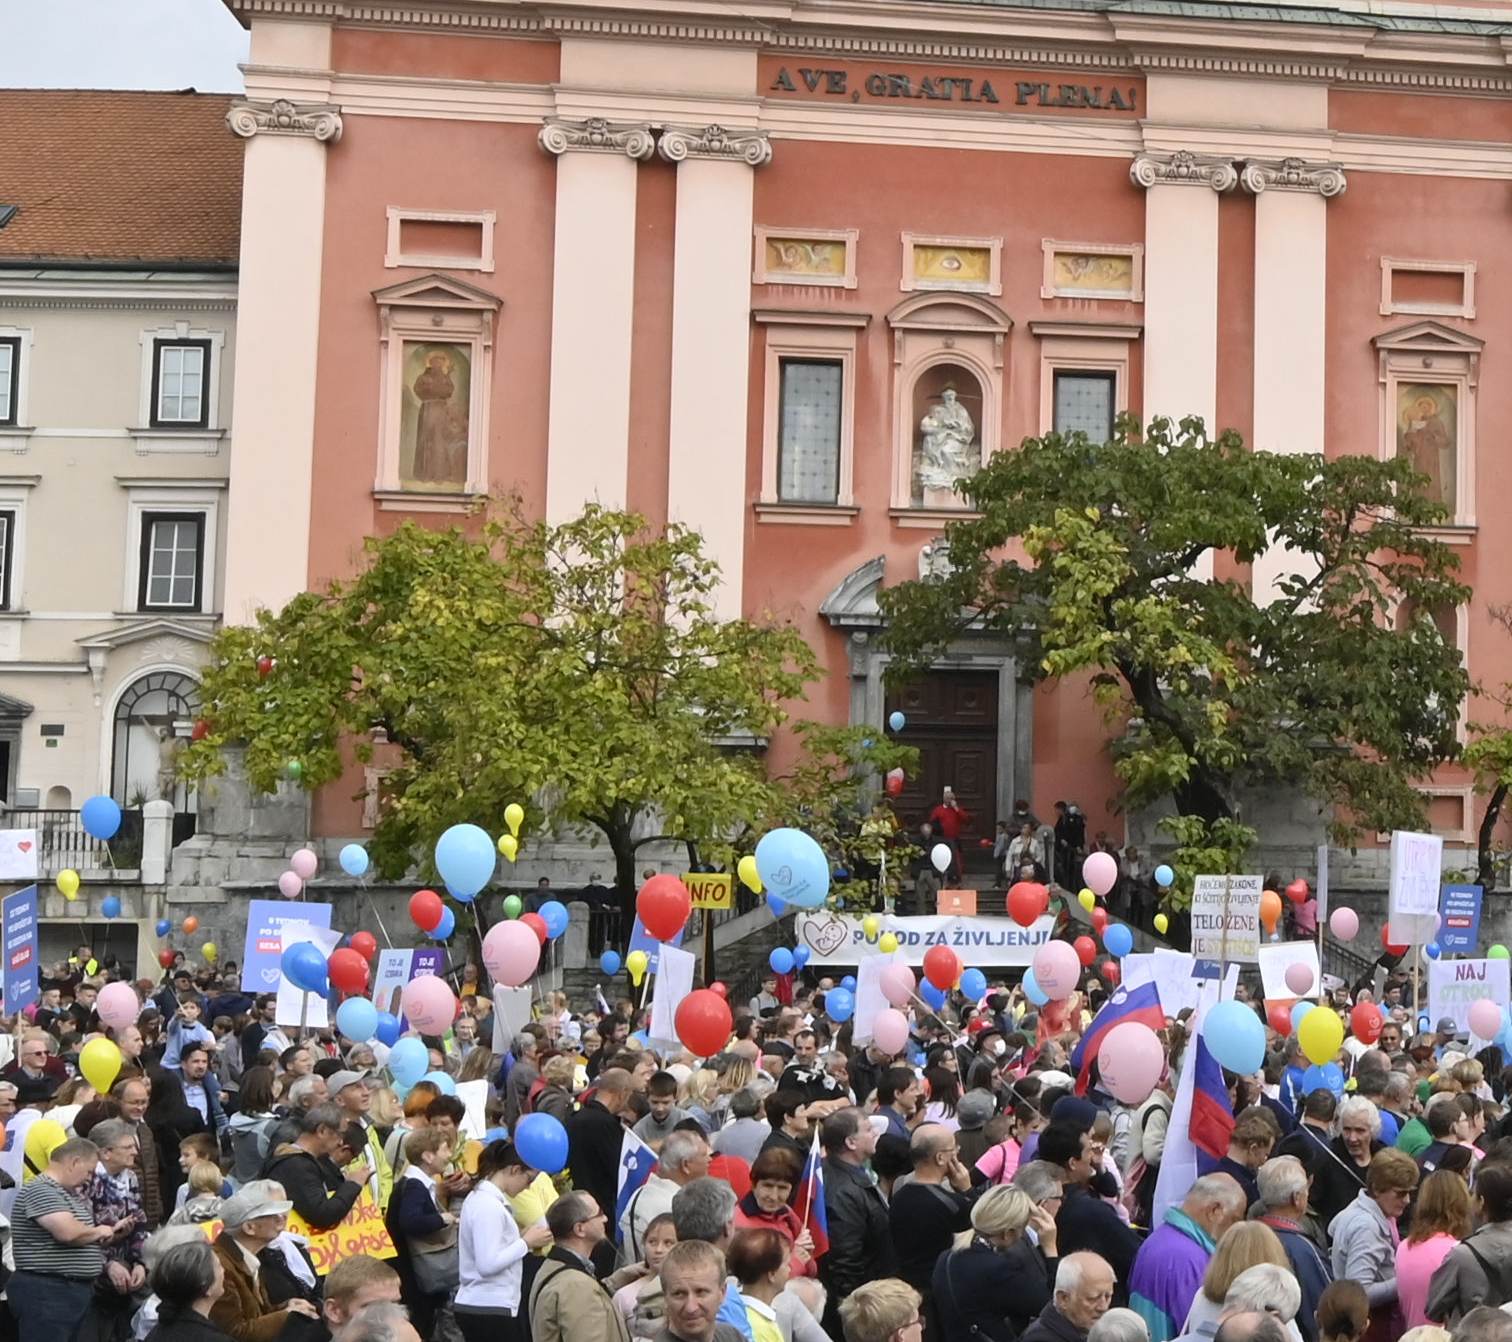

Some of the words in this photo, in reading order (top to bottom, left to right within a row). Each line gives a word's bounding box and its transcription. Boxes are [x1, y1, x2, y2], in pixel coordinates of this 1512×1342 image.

[770, 66, 861, 103] AVE,
[866, 73, 1000, 104] GRATIA
[1016, 81, 1138, 111] PLENA!
[853, 930, 920, 945] POOD
[925, 931, 948, 946] ZA
[1455, 962, 1487, 982] NAJ
